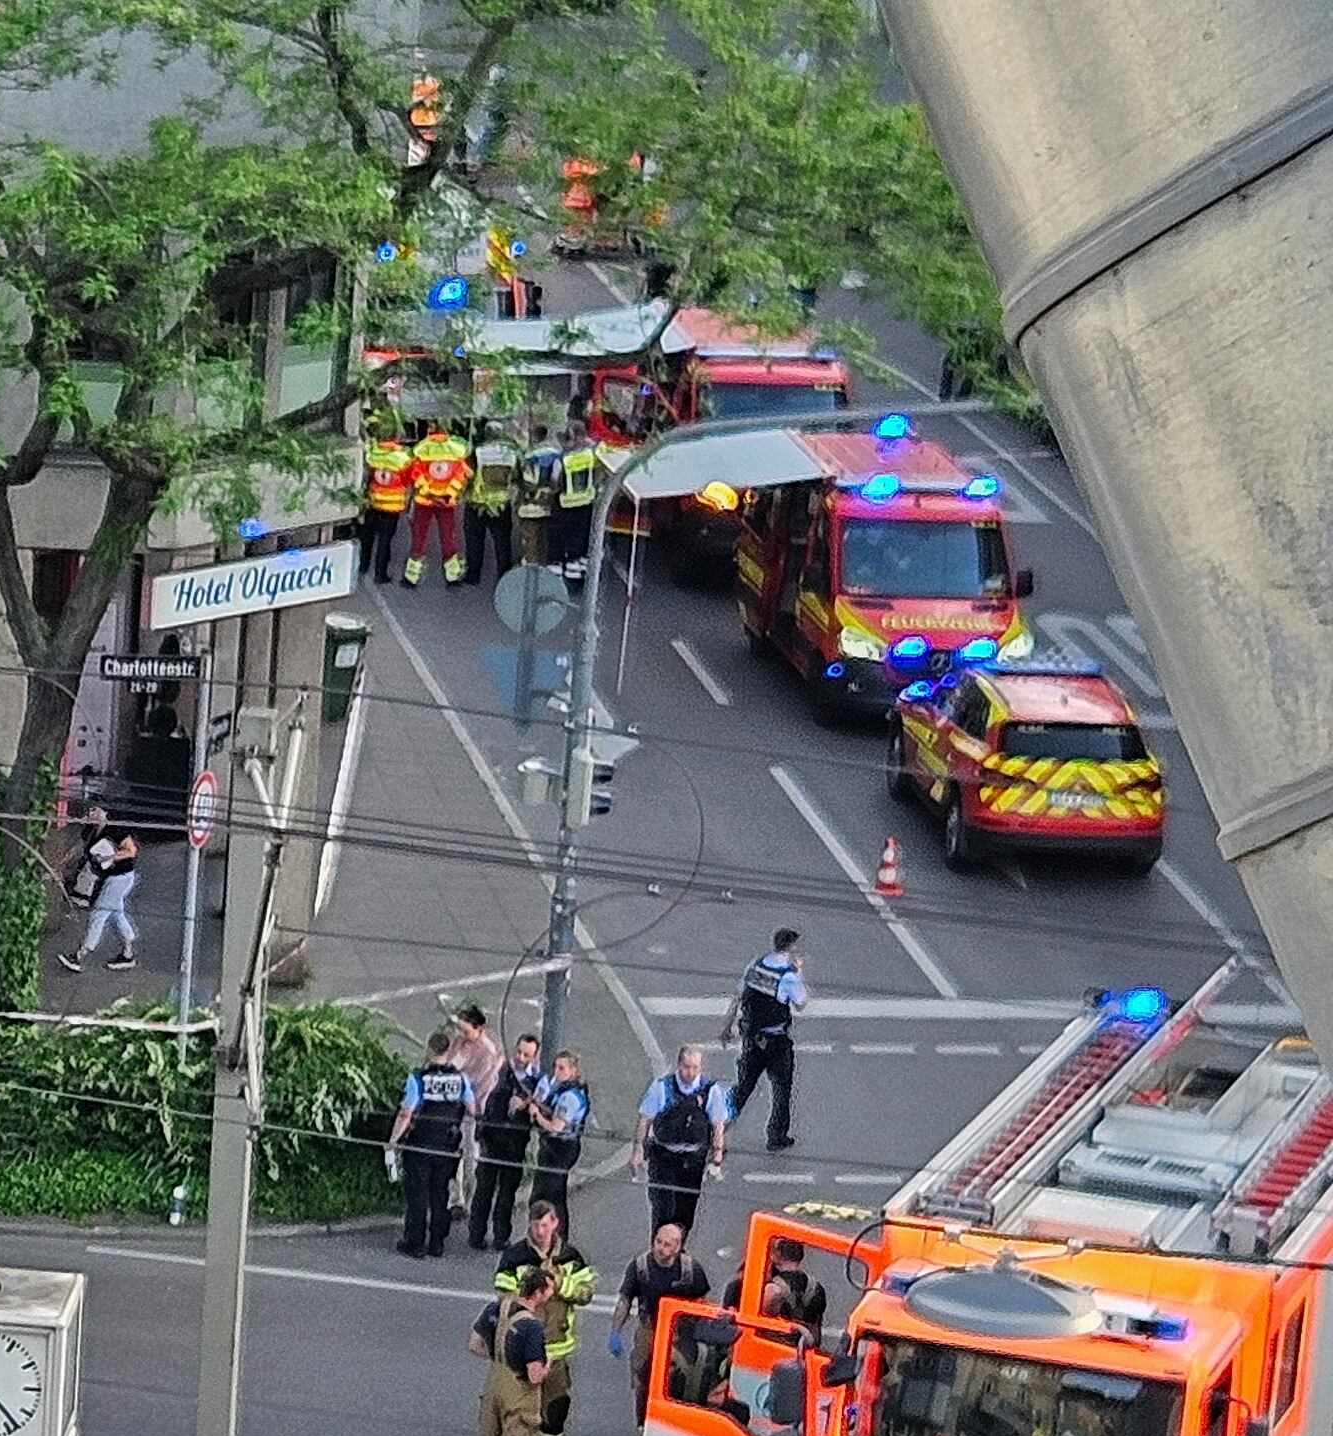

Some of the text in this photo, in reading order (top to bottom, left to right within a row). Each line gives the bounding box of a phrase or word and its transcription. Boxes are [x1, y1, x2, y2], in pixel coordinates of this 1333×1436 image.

[173, 555, 333, 612] Hotel Olgaeck
[103, 658, 197, 677] Charlottenstr.
